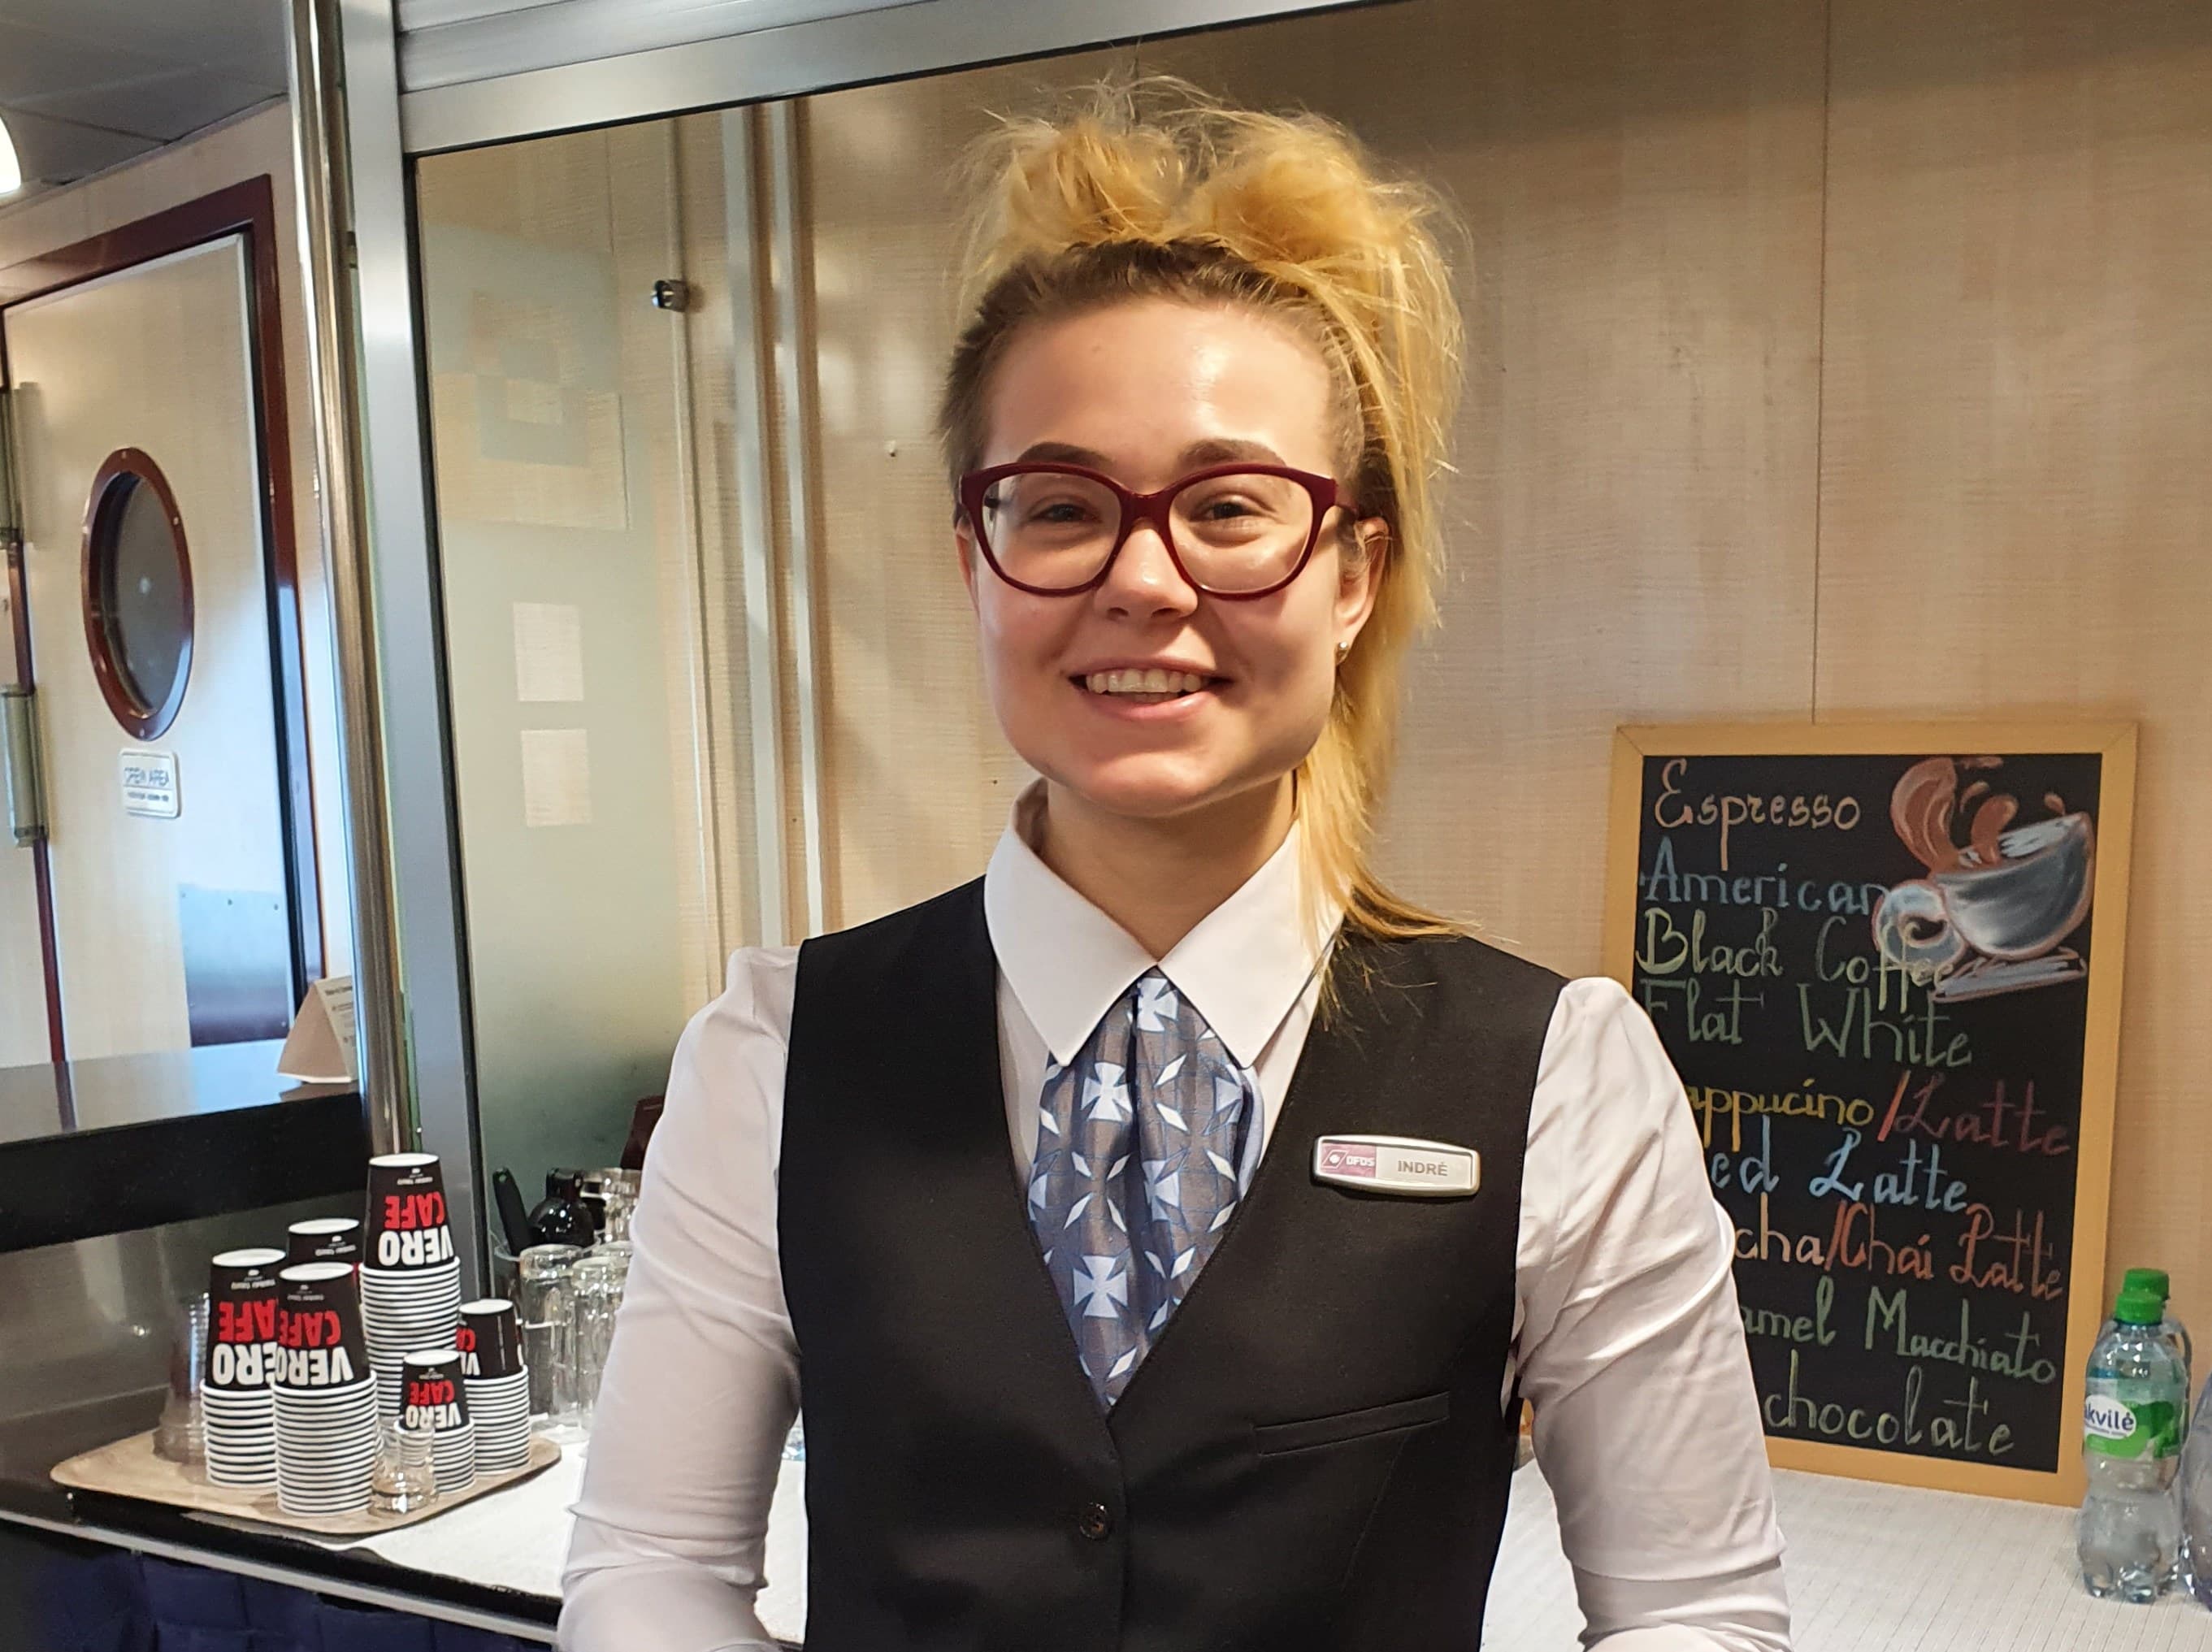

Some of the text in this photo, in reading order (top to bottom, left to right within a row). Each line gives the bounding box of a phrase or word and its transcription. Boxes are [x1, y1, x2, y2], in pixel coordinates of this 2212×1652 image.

[1654, 758, 1861, 871] Espresso
[1635, 907, 1784, 977] Black
[1641, 979, 1972, 1067] Flat White
[1711, 1113, 1968, 1212] ed Latte
[384, 1191, 445, 1229] CAFE
[378, 1225, 454, 1266] VERO
[218, 1299, 278, 1342] AFE
[279, 1310, 341, 1347] CAFE
[1740, 1275, 2056, 1384] amel Macchiato
[212, 1341, 277, 1385] ERO
[275, 1346, 354, 1385] VERO
[409, 1380, 455, 1406] CAFE
[1763, 1349, 2015, 1456] chocolate
[405, 1402, 462, 1429] VERO
[2085, 1403, 2135, 1431] kvilė
